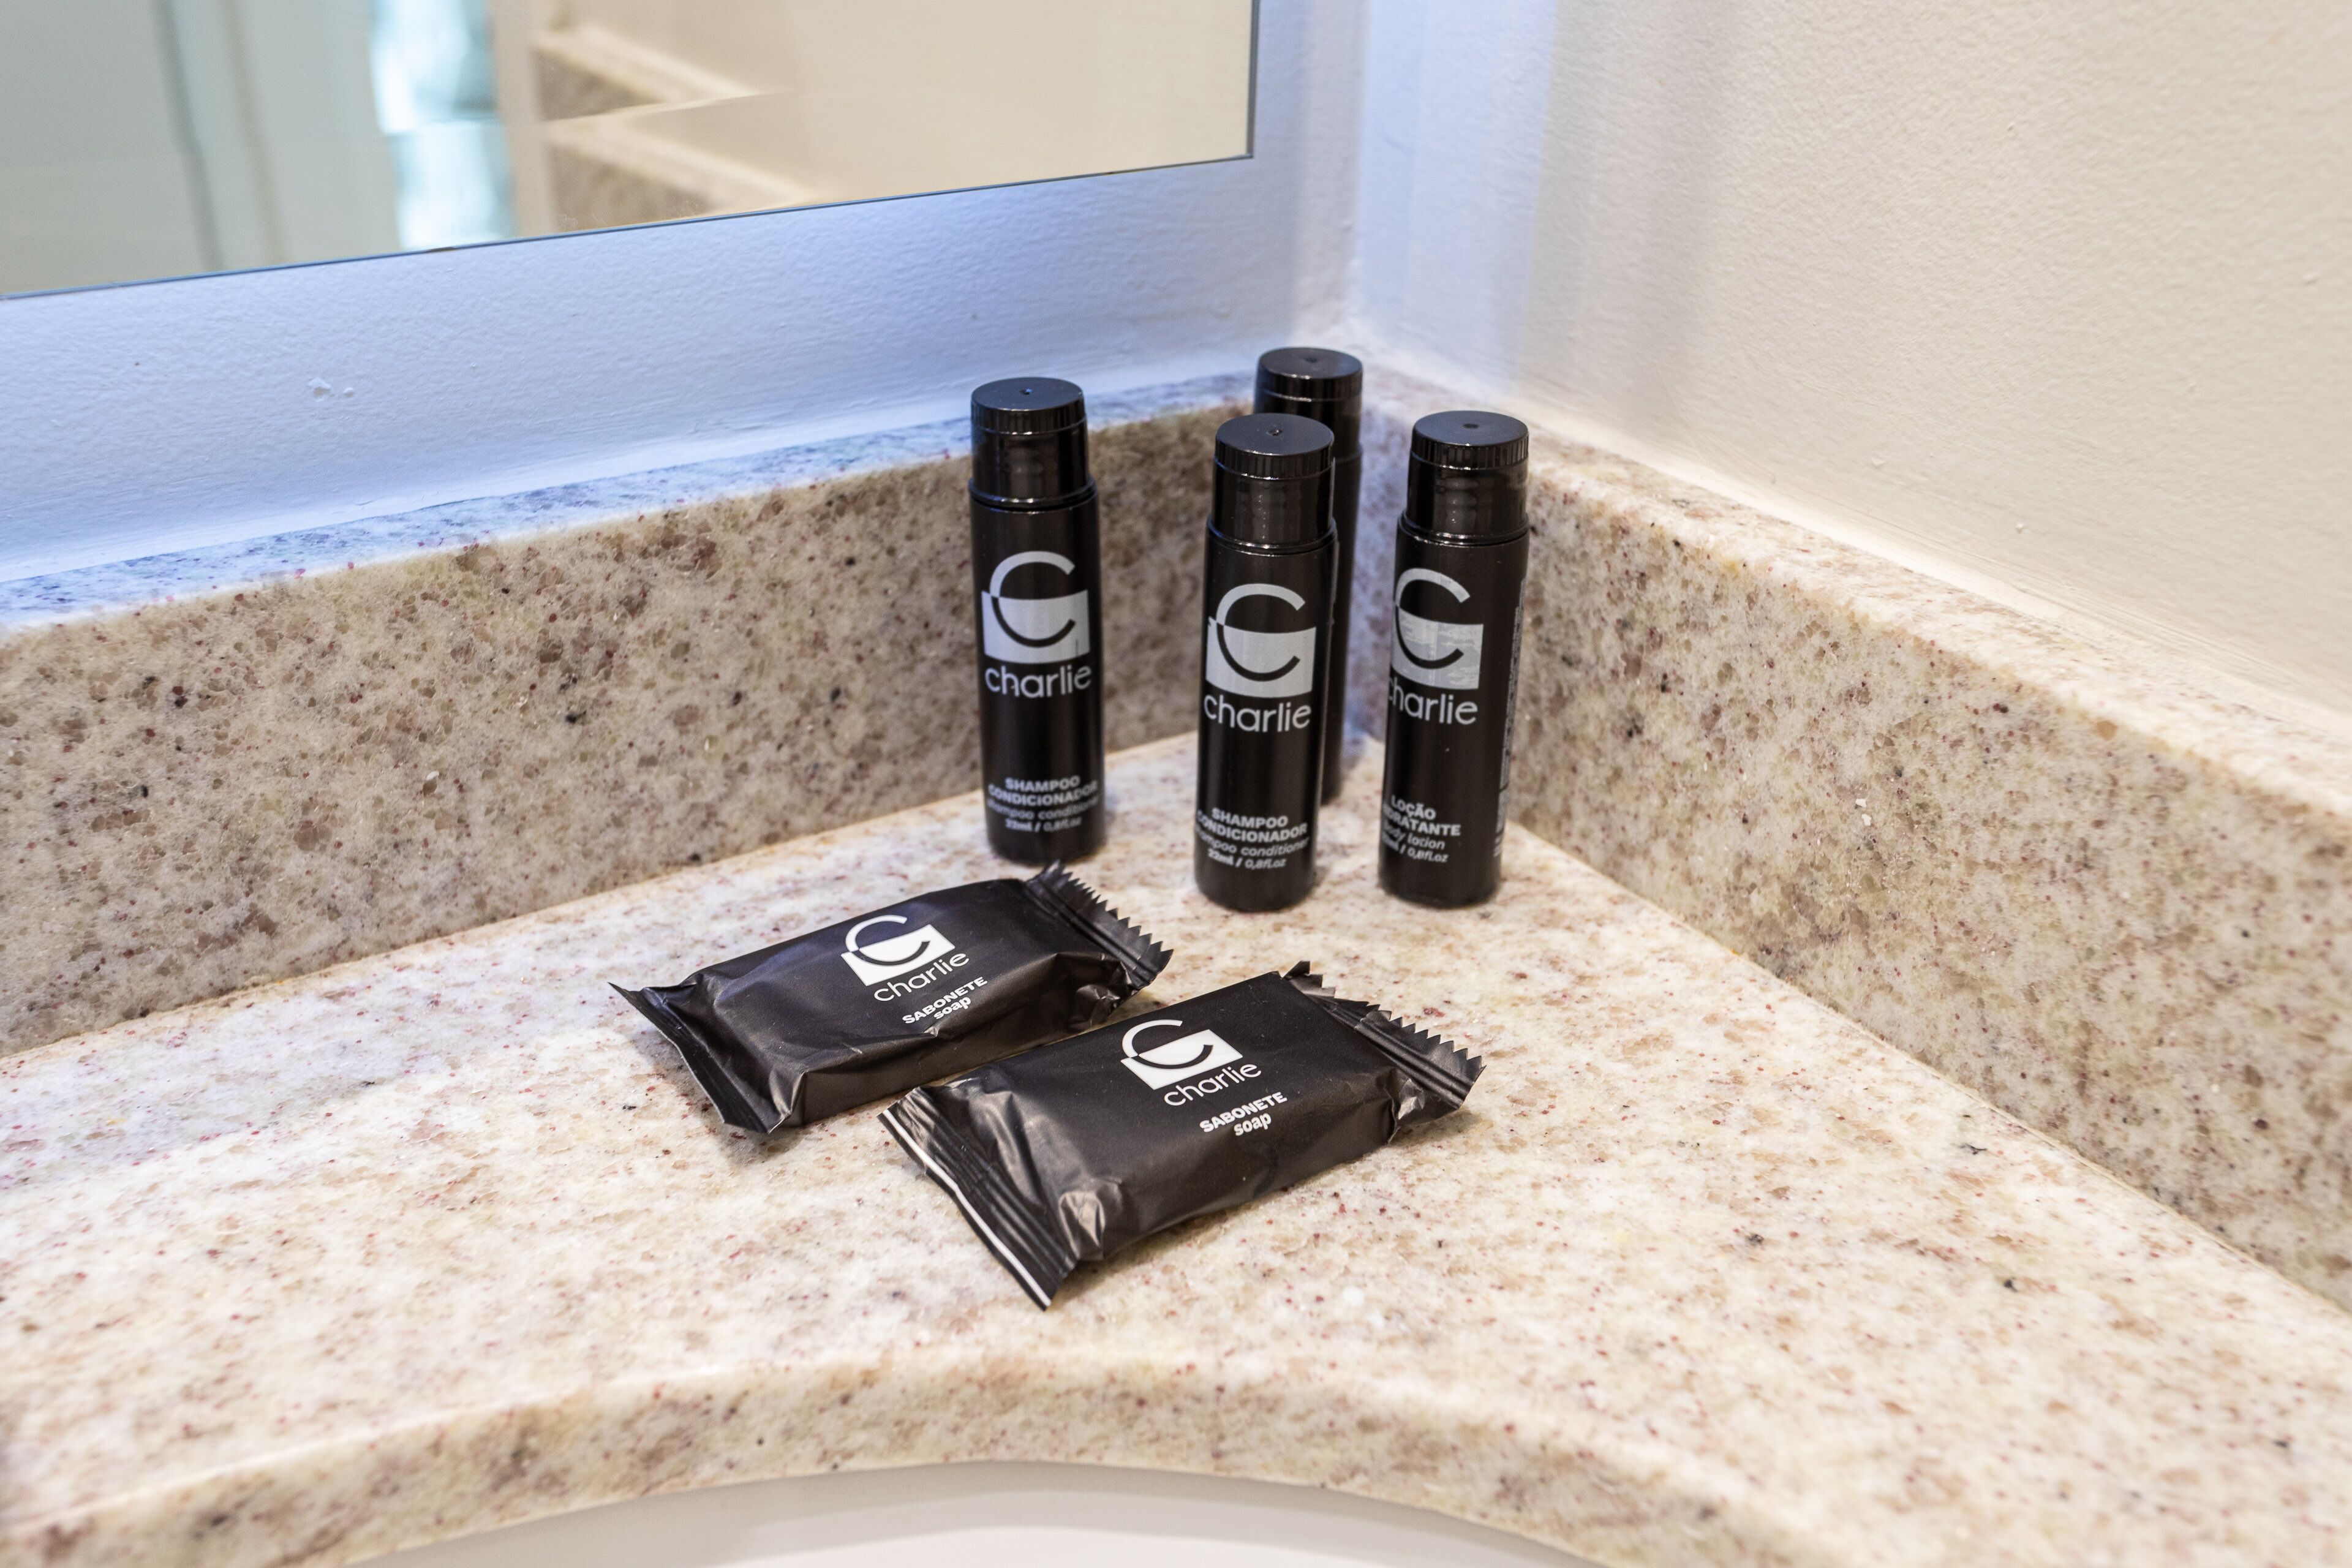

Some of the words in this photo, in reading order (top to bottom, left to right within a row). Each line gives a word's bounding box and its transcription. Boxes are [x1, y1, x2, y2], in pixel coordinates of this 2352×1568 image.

[985, 665, 1091, 698] charlie
[1204, 694, 1312, 733] charlie
[988, 780, 1098, 807] CONDICIONADOR
[1005, 775, 1081, 793] SHAMPOO
[1212, 807, 1289, 829] SHAMPOO
[1390, 794, 1437, 821] LOÇÃO
[1240, 837, 1310, 857] conditioner
[1407, 832, 1446, 850] lotion
[873, 953, 970, 1001] charlie
[902, 976, 988, 1024] SABONETE
[933, 997, 971, 1020] soap
[1164, 1064, 1262, 1106] charlie
[1199, 1091, 1287, 1133] SABONETE
[1234, 1112, 1272, 1136] soap
